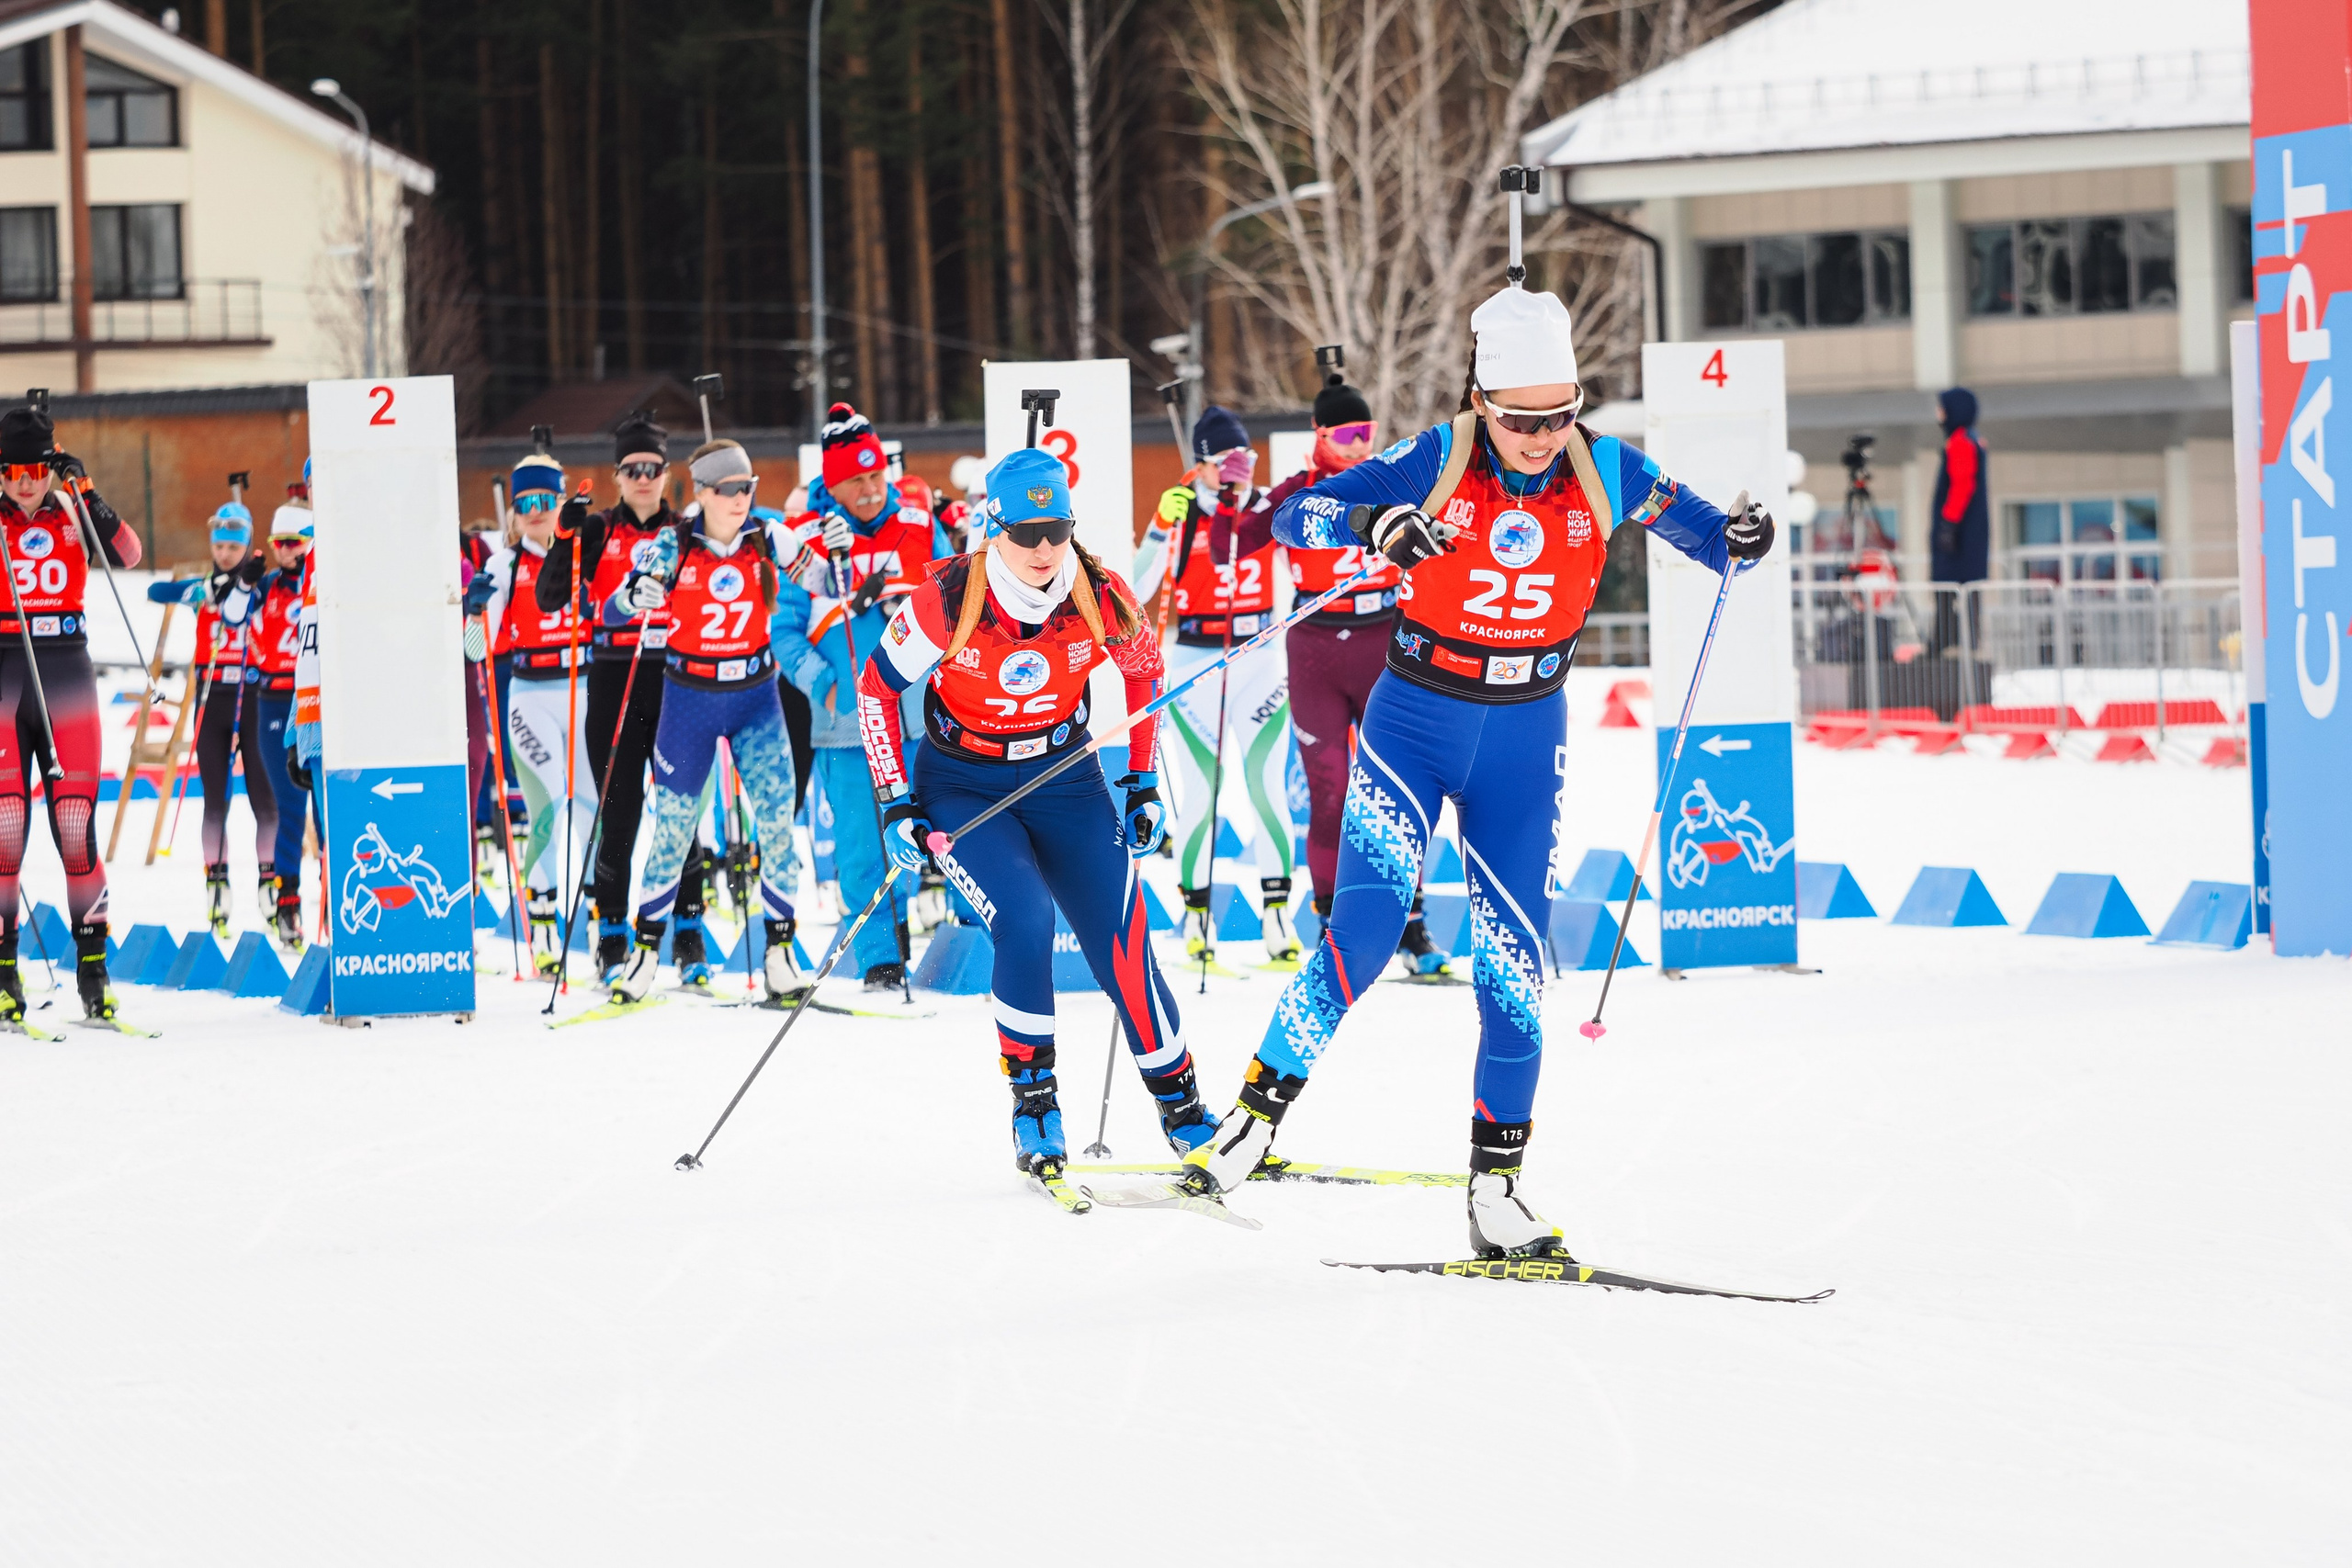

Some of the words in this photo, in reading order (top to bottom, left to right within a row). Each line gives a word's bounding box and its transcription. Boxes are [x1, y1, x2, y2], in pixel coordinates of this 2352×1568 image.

[1701, 349, 1728, 387] 4
[368, 386, 396, 426] 2
[2282, 149, 2341, 720] СТАРТ
[1041, 430, 1080, 491] 3
[11, 558, 69, 595] 30
[1214, 558, 1262, 597] 32
[1462, 569, 1555, 620] 25
[699, 600, 754, 640] 27
[1459, 621, 1547, 640] КРАСНОЯРСК
[1661, 904, 1796, 931] КРАСНОЯРСК
[334, 950, 471, 977] КРАСНОЯРСК
[1177, 1067, 1193, 1085] 176
[1236, 1098, 1272, 1122] SCHER
[1500, 1129, 1523, 1142] 175
[1400, 1173, 1470, 1185] FISCHE
[1442, 1259, 1564, 1280] FISCHER
